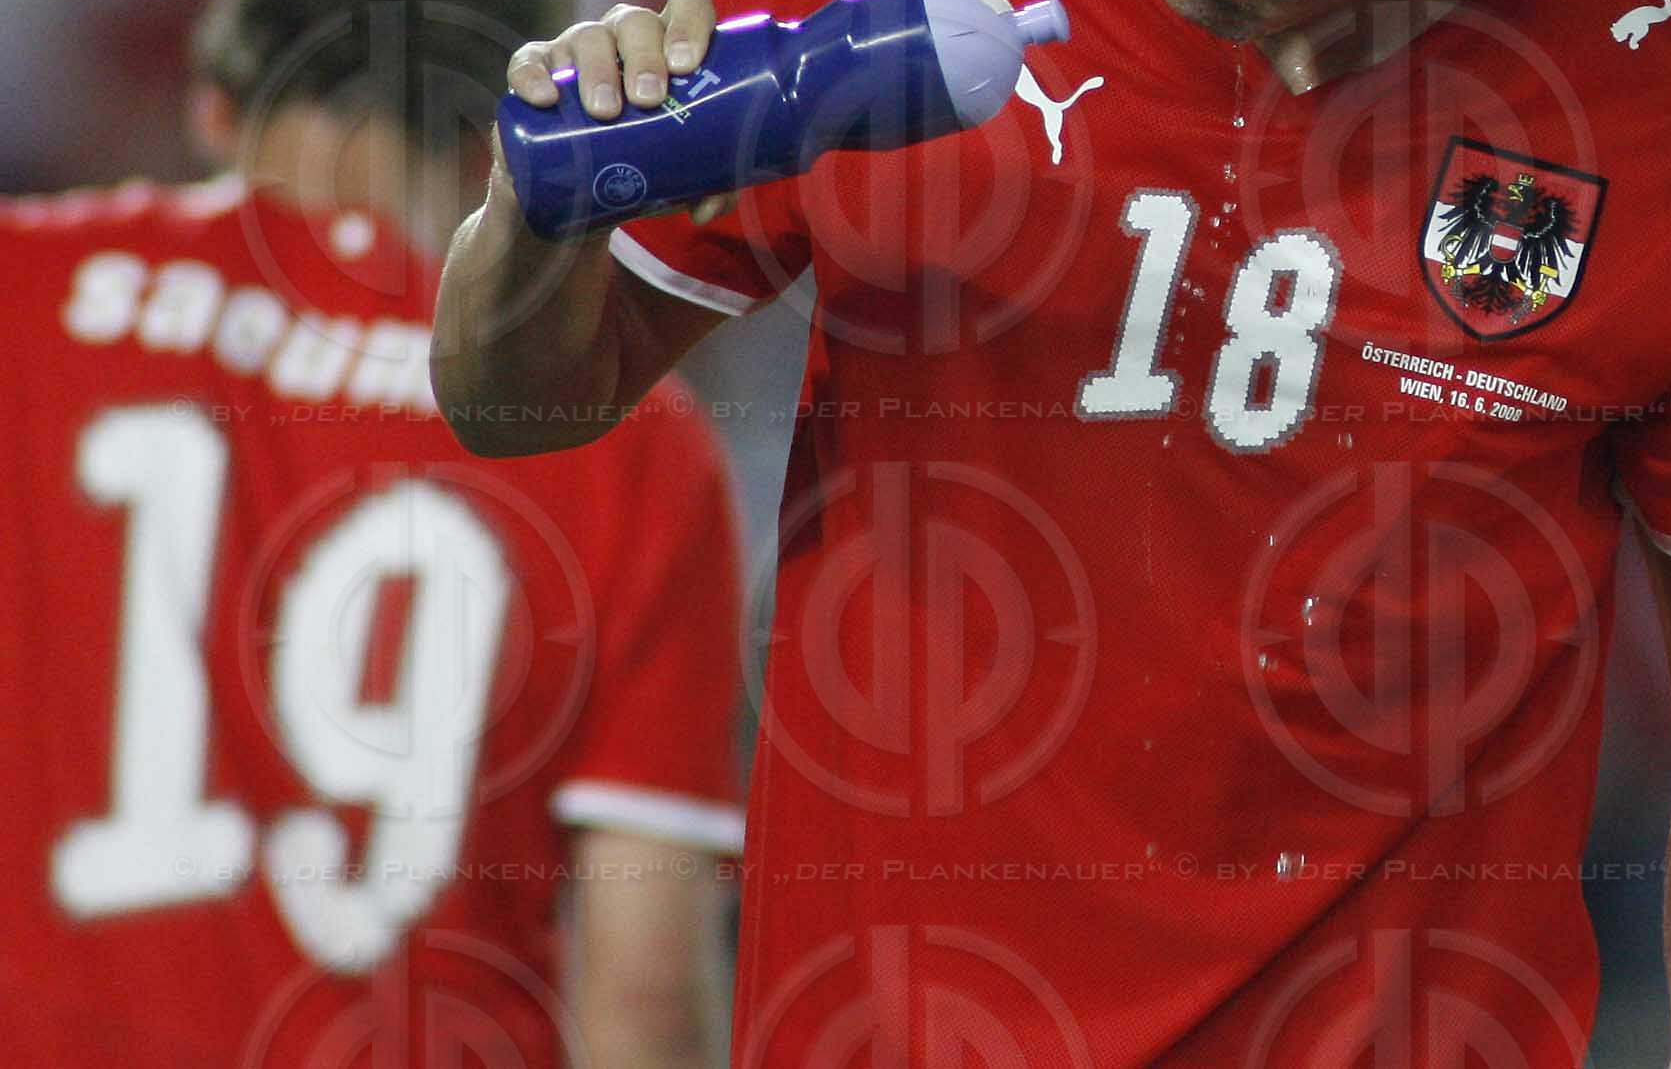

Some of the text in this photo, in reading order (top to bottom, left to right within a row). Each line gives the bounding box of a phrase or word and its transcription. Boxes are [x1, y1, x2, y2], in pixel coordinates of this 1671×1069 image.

[1077, 188, 1342, 454] 18
[1361, 341, 1454, 381] ÖSTERREICH
[1465, 370, 1568, 412] DEUTSCHLAND
[1400, 376, 1523, 422] WIEN, 16. 6. 2008
[50, 403, 511, 975] 19
